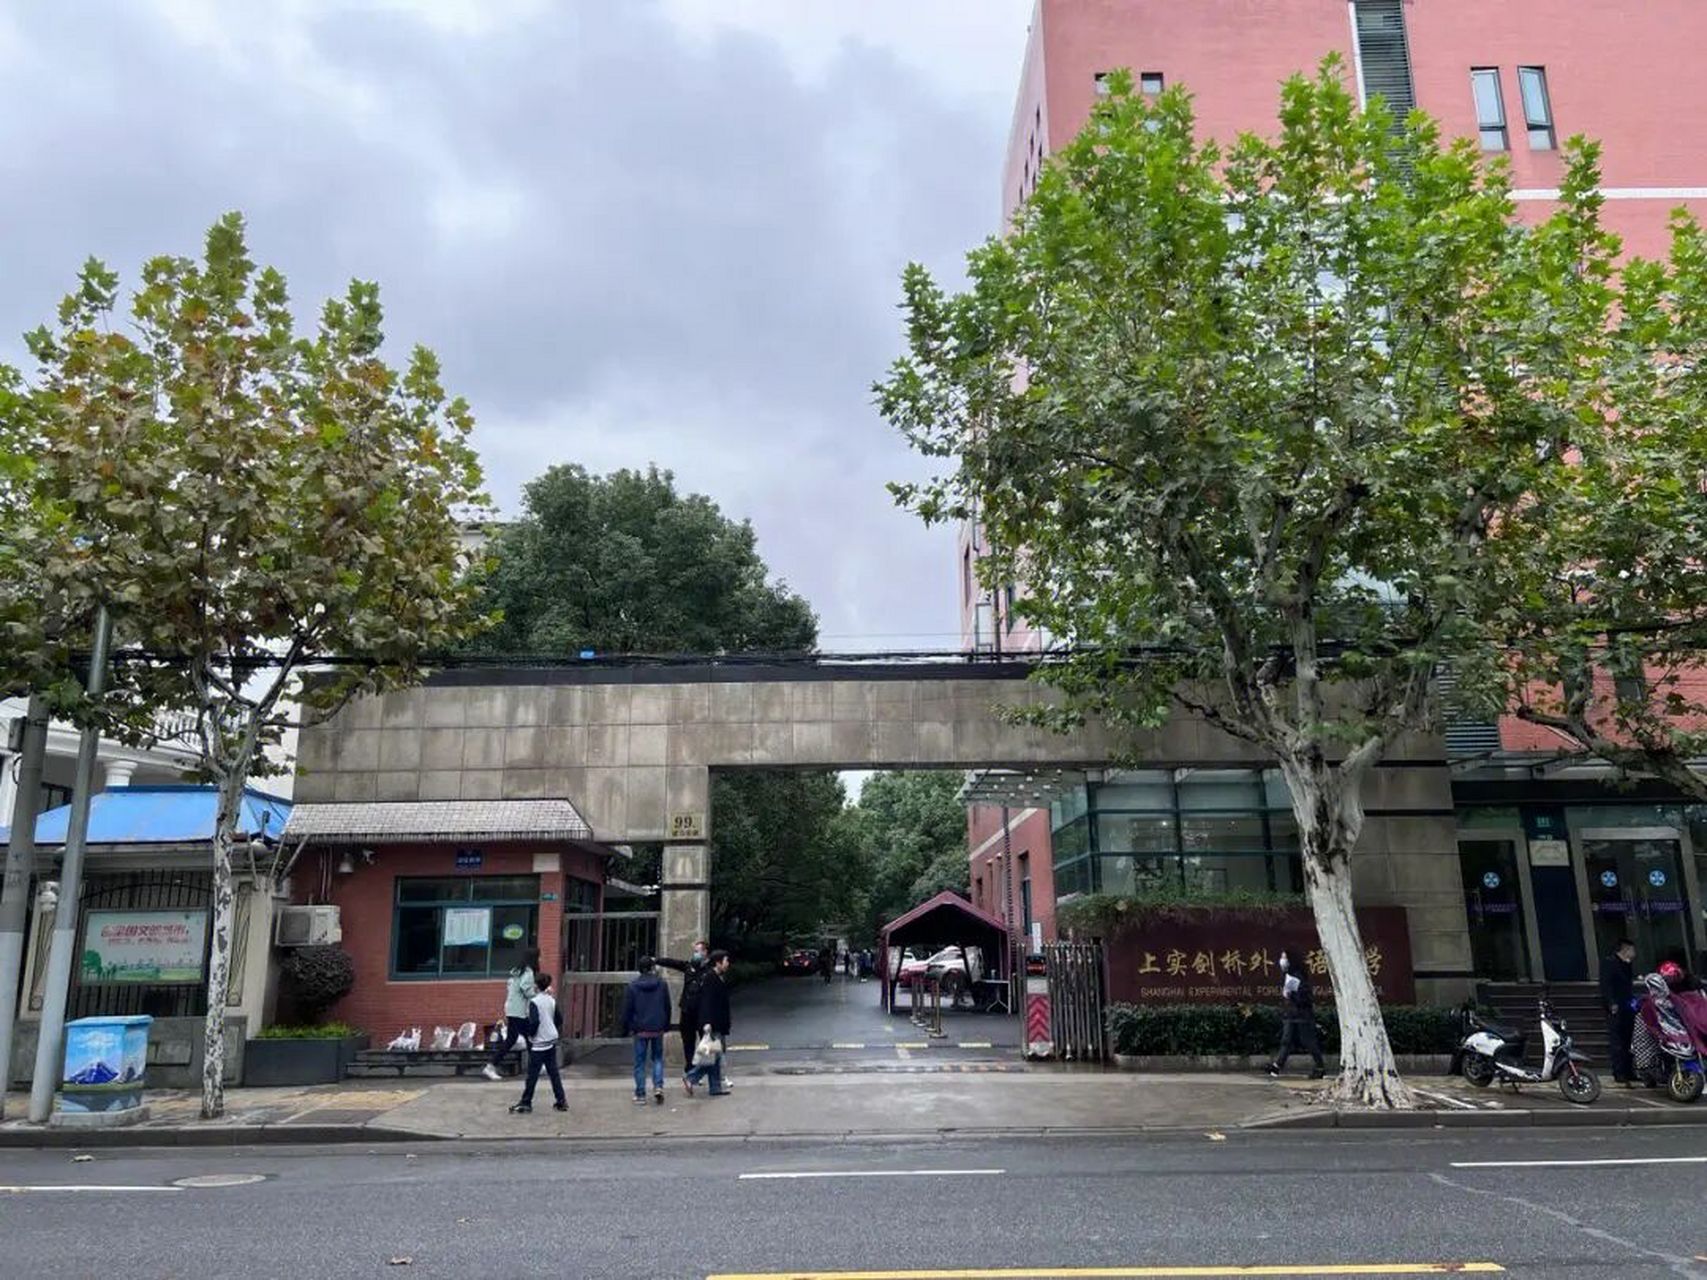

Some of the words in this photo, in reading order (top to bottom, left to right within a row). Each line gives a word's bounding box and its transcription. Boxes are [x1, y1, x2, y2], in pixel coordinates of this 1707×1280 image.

[1138, 947, 1383, 977] 上实剑桥外语学
[1140, 985, 1185, 998] SHANGHAI
[1188, 985, 1252, 998] EXPERIMENTAL
